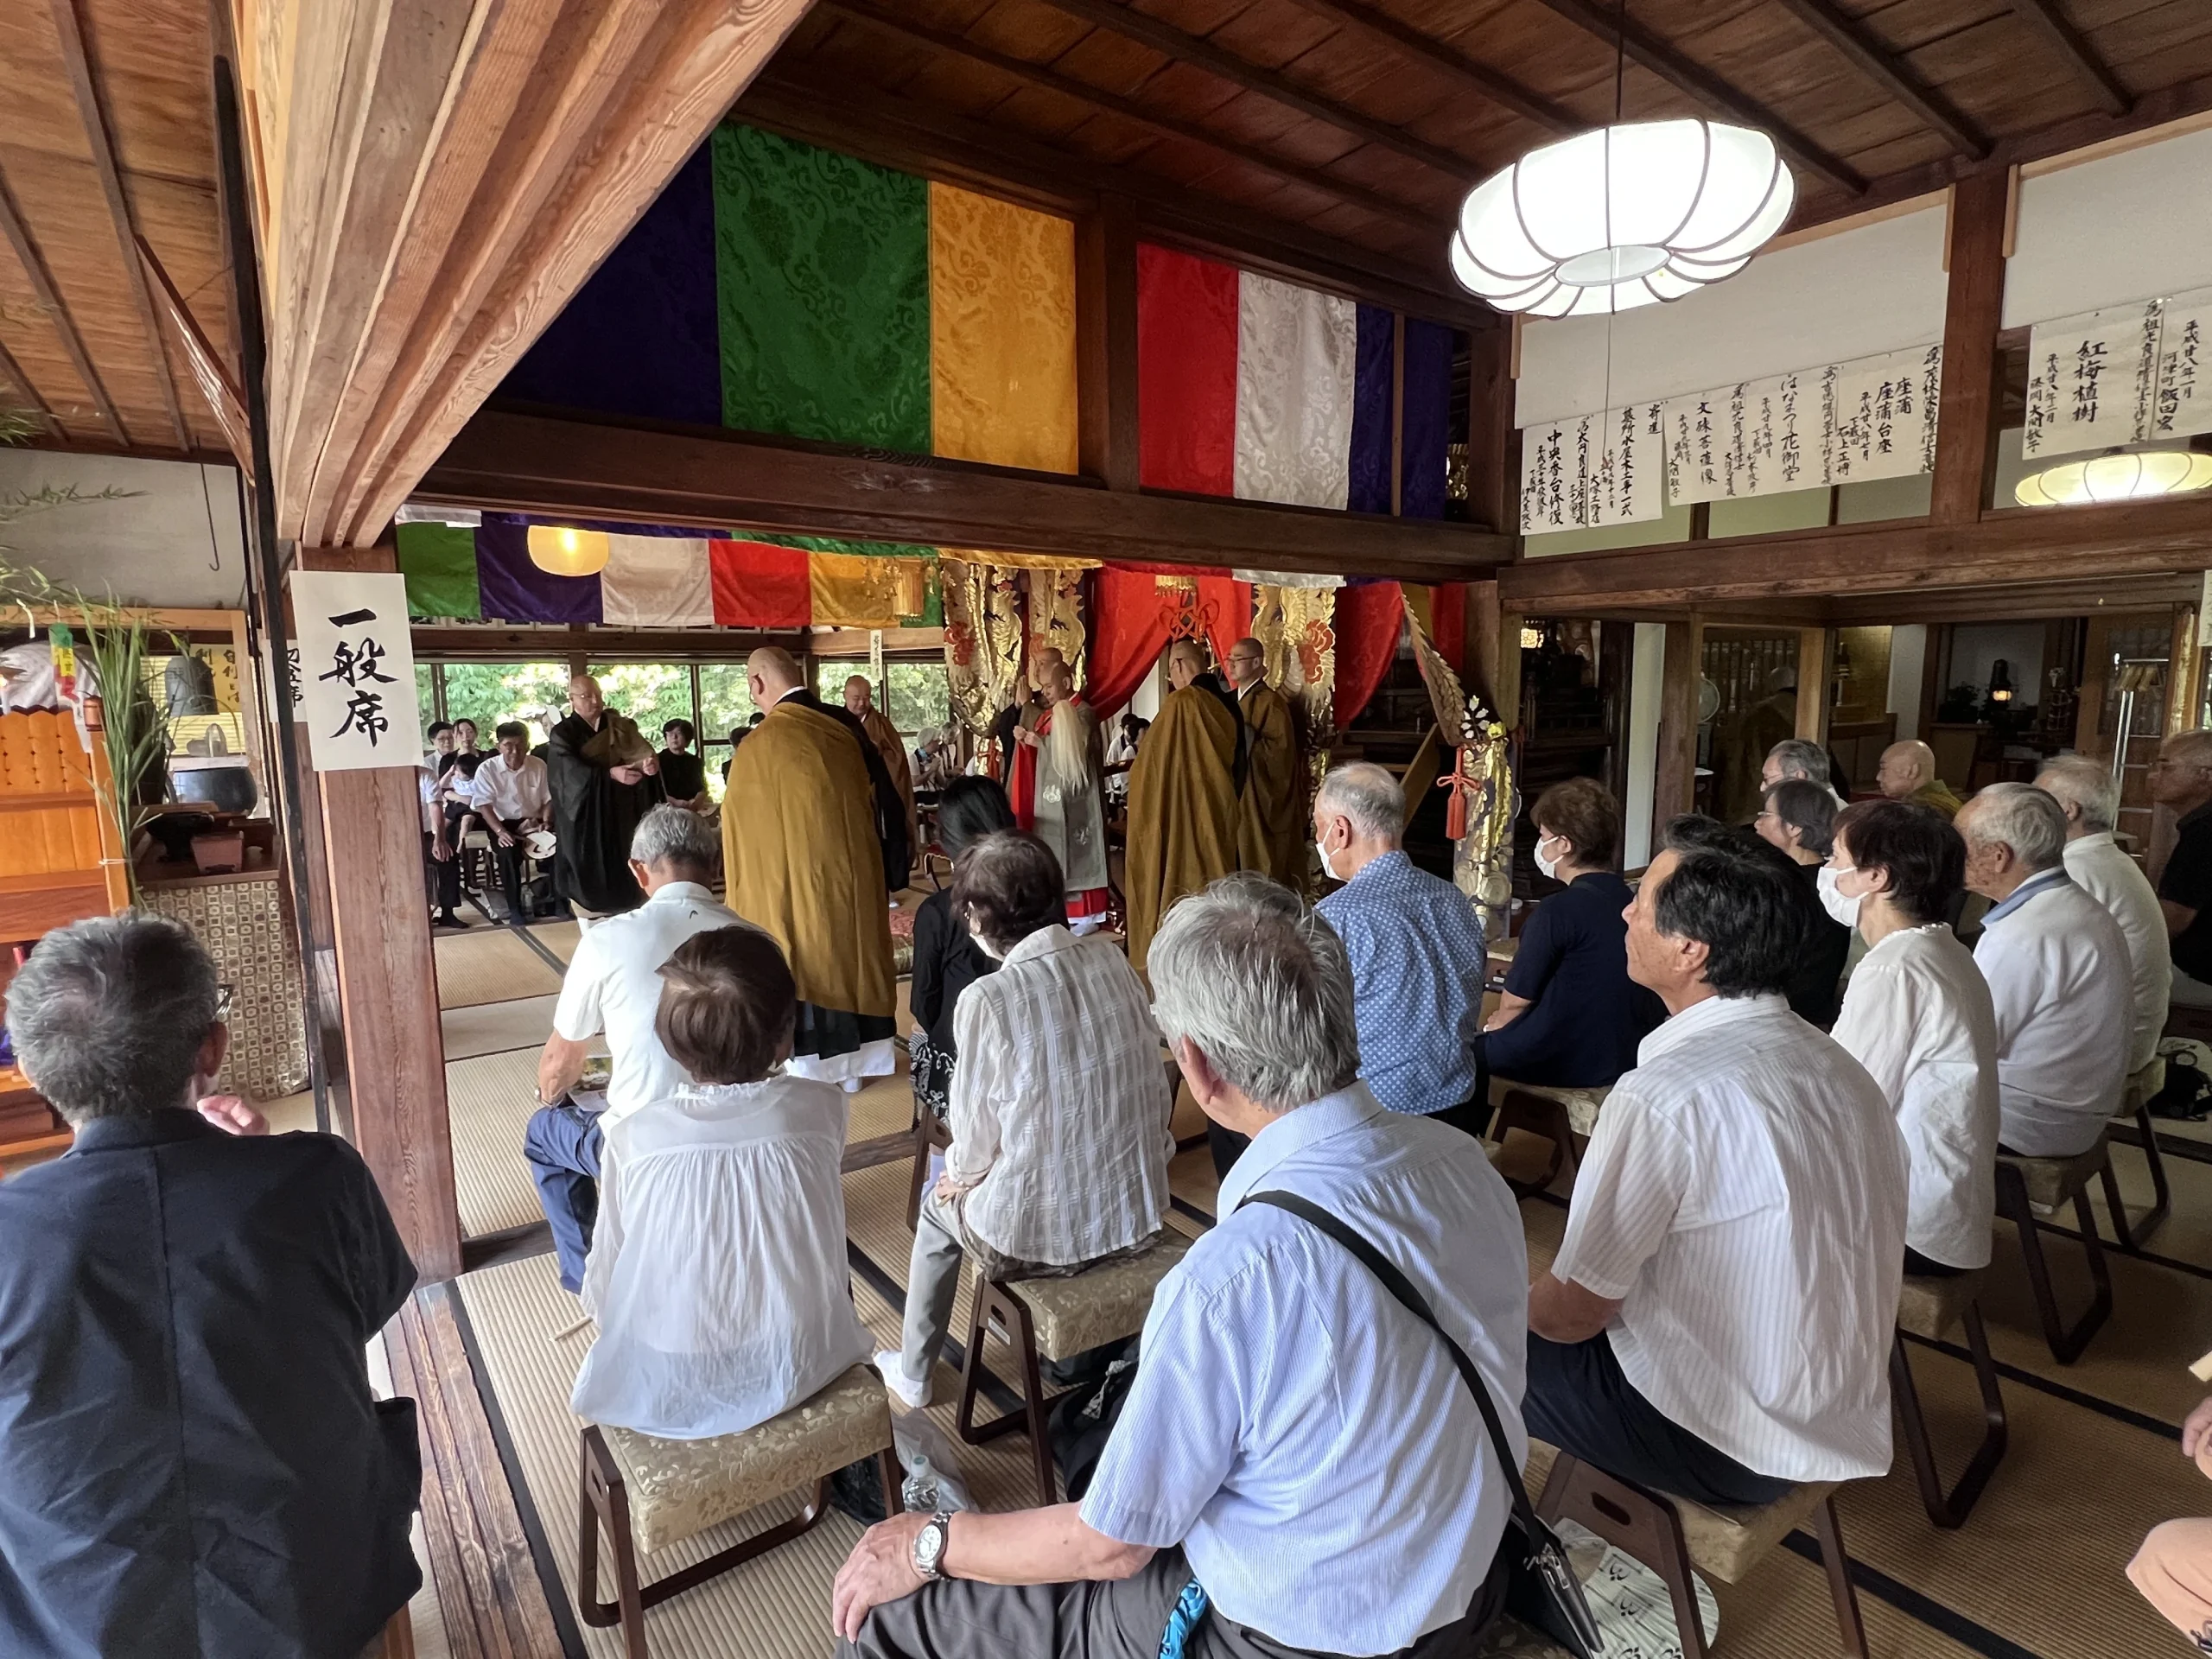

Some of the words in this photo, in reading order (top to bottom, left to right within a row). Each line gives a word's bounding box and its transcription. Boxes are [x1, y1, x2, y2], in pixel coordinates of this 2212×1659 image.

[1648, 404, 1663, 435] 寄進
[1874, 381, 1894, 454] 座蒲台座
[1895, 377, 1913, 414] 座蒲
[2070, 340, 2108, 423] 紅梅植樹
[1781, 377, 1800, 482] はなまつり花御堂
[1548, 429, 1564, 525] 中央香台修復
[318, 607, 399, 748] 一般席
